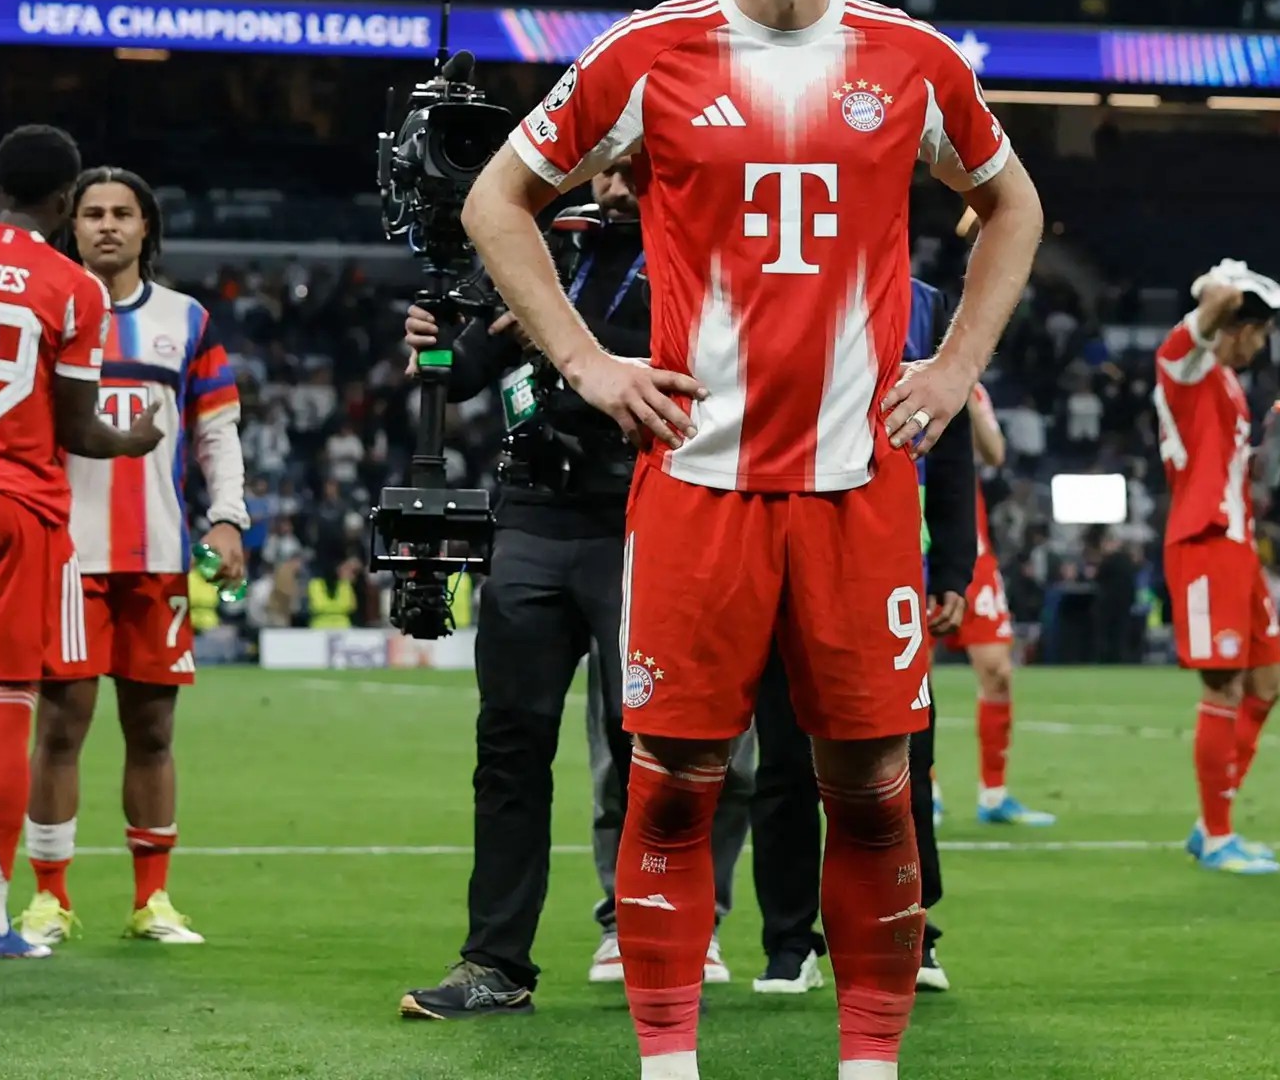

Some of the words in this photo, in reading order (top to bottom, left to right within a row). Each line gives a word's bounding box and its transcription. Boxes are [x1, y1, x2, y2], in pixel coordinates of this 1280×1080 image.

[18, 2, 103, 36] UEFA
[107, 5, 303, 44] CHAMPIONS
[306, 14, 431, 48] LEAGUE
[744, 163, 838, 274] T
[886, 585, 924, 671] 9
